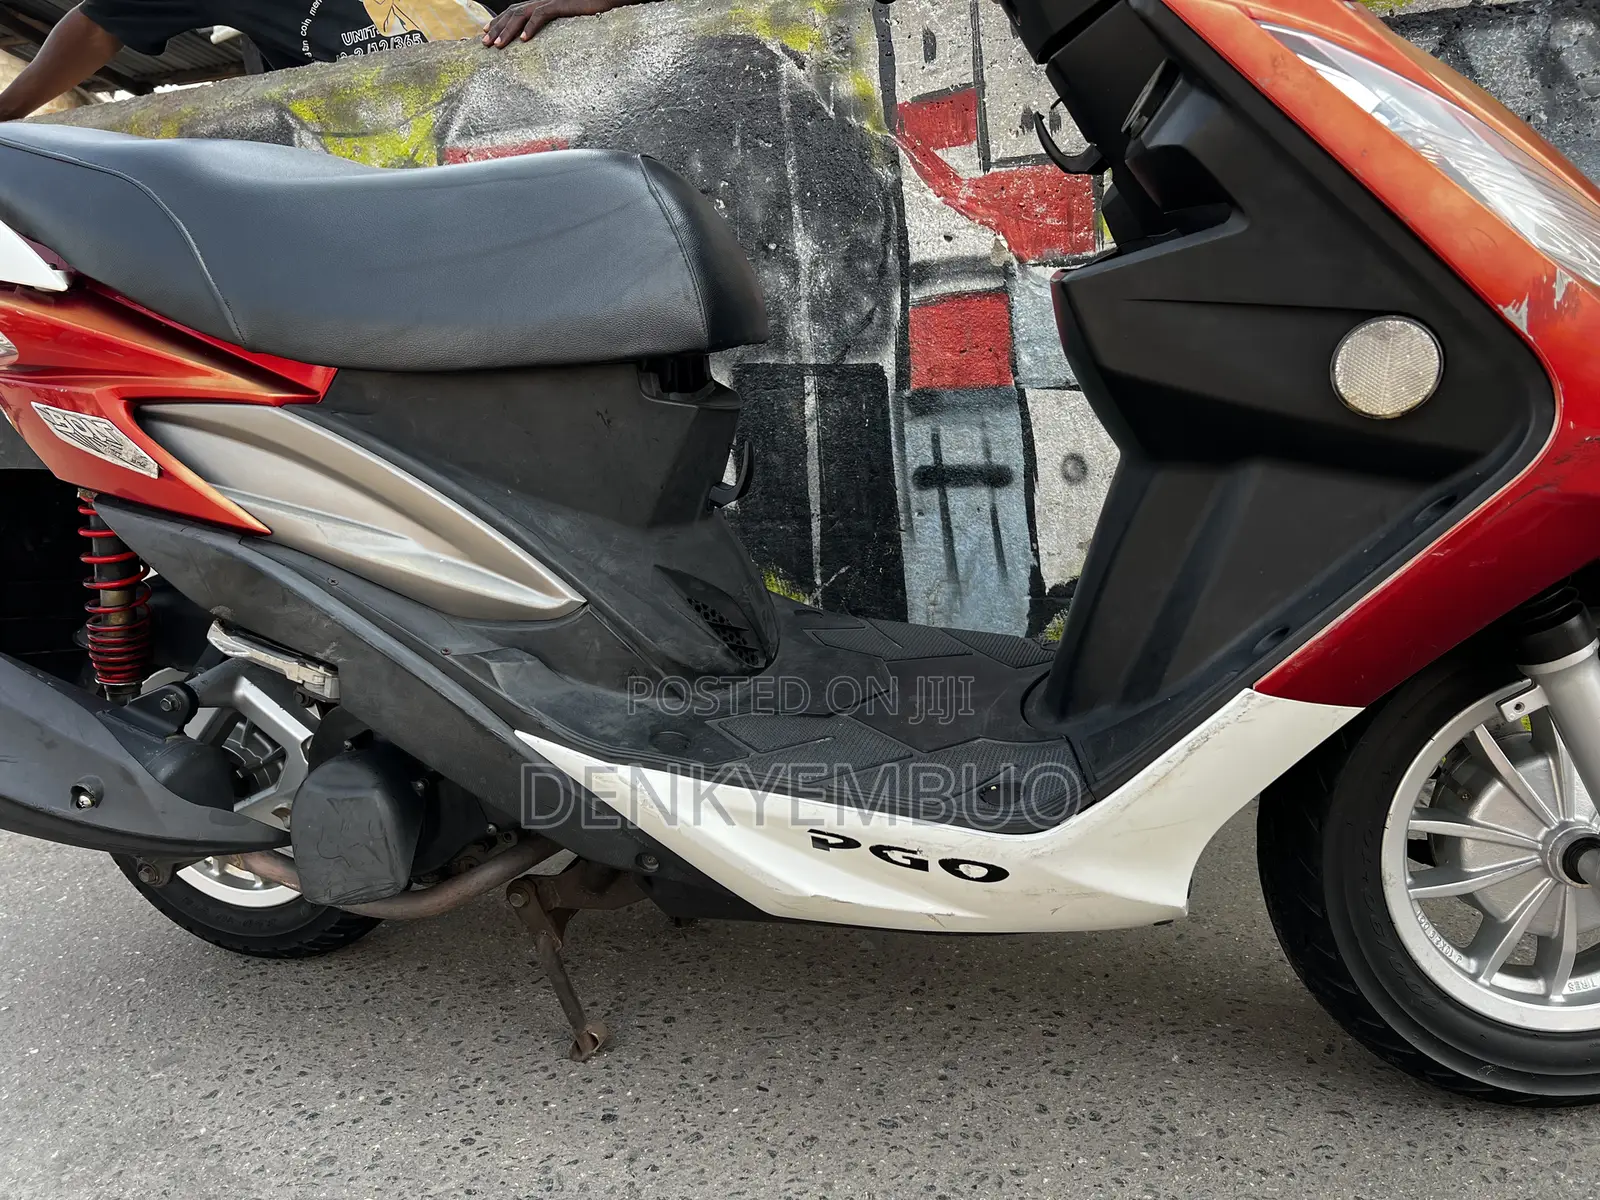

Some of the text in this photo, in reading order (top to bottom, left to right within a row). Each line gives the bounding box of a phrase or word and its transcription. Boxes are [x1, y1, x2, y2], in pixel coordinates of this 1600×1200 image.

[300, 18, 312, 37] coin
[341, 24, 380, 46] UNIT
[807, 828, 1010, 883] PGO
